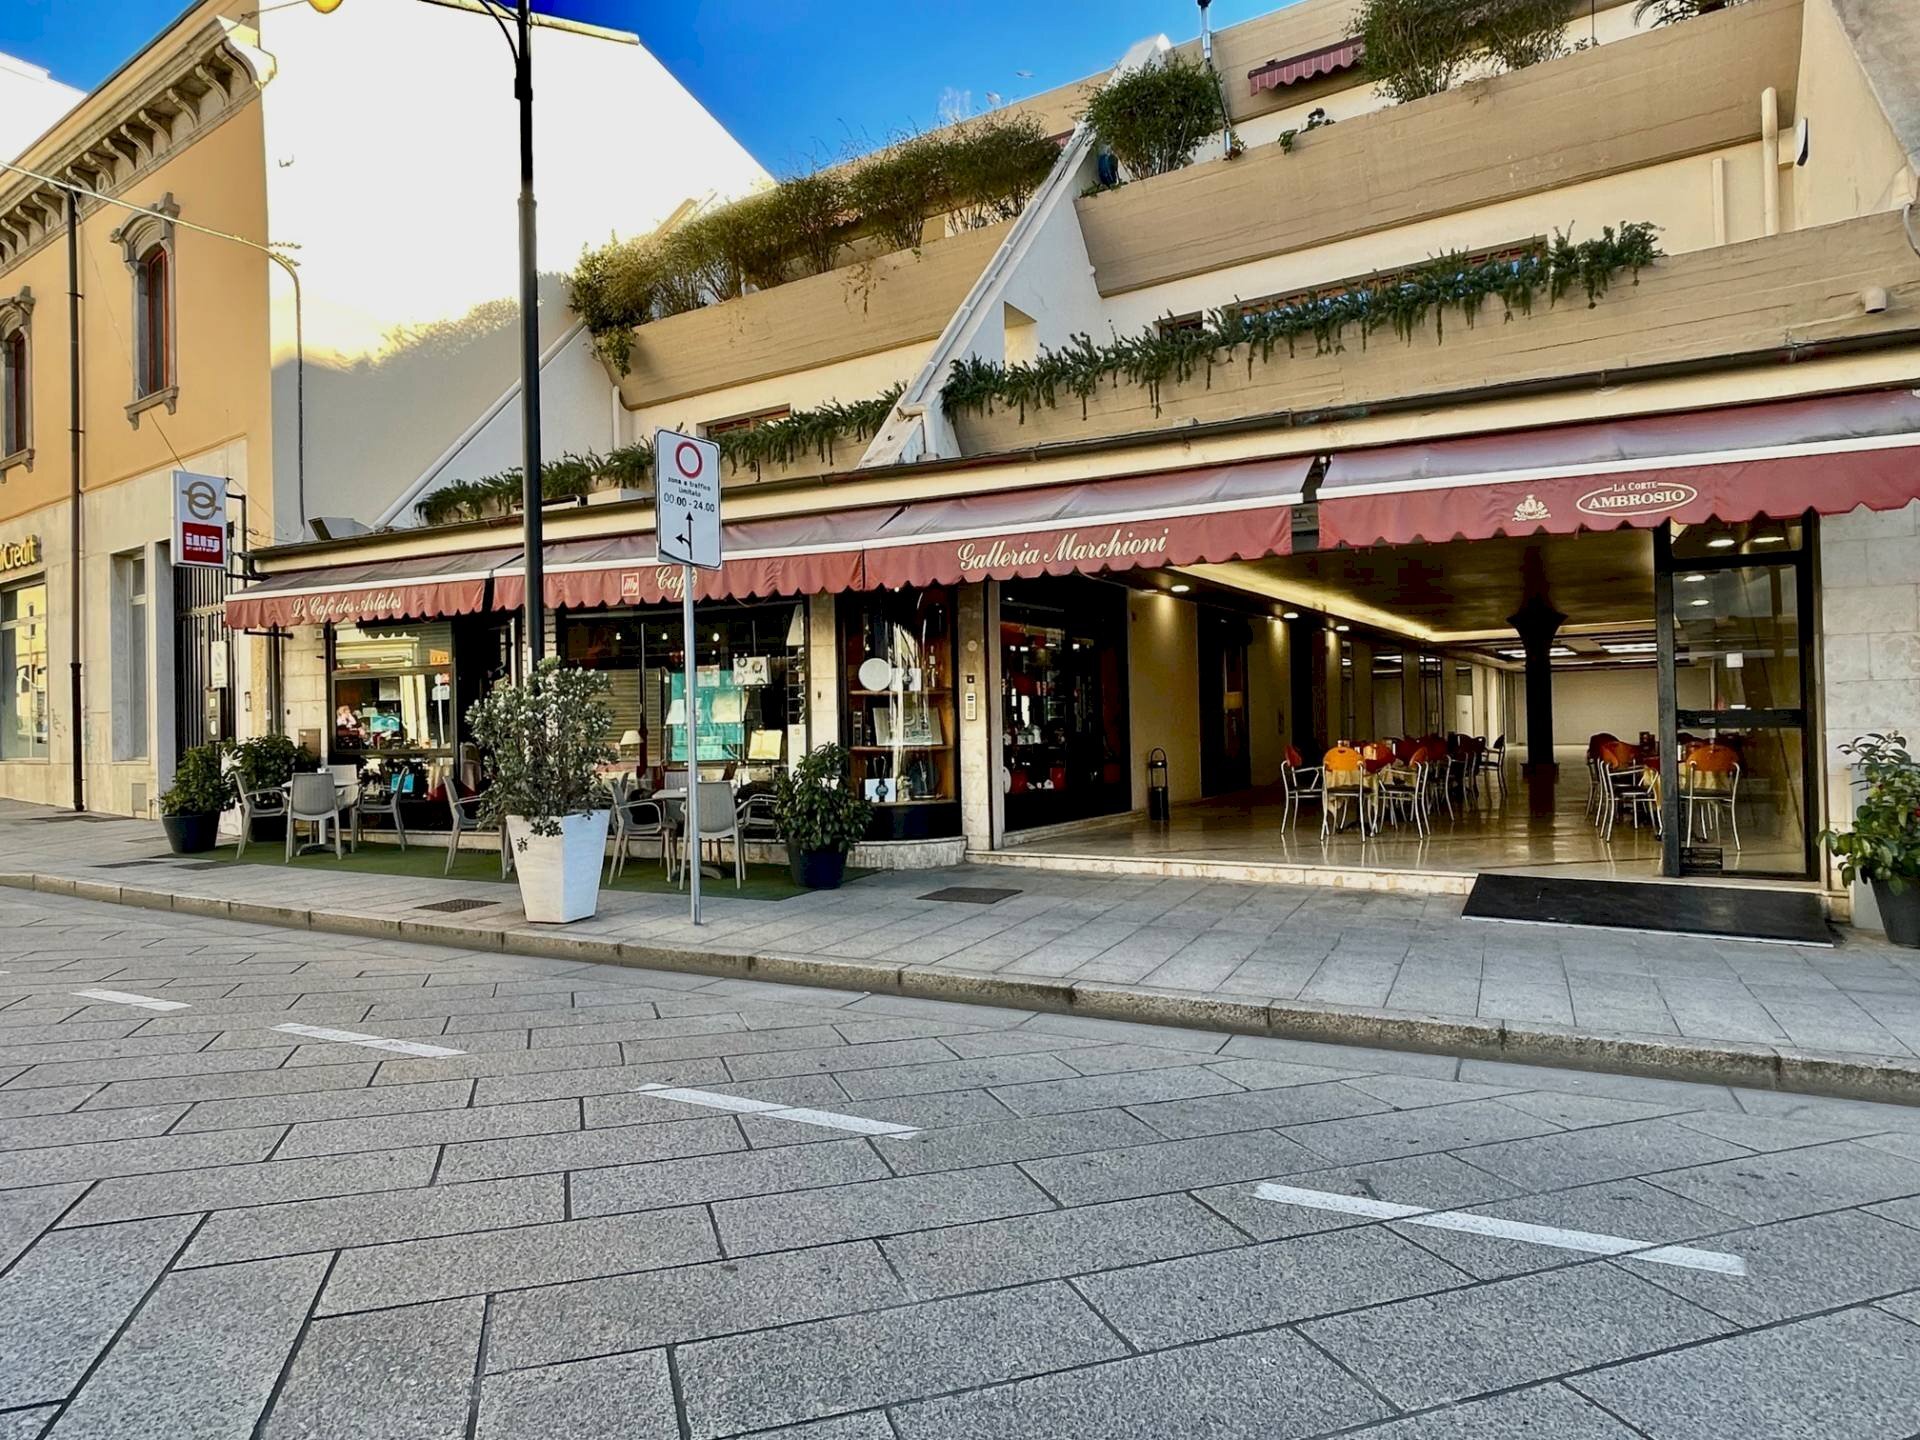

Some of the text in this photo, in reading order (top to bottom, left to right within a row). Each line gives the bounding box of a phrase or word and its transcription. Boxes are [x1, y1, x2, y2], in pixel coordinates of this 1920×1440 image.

[693, 499, 715, 512] 24.00
[1588, 490, 1686, 509] AMBROSIO
[957, 527, 1169, 571] Galleria Marchioni
[335, 597, 354, 614] des
[355, 591, 402, 612] Artistes
